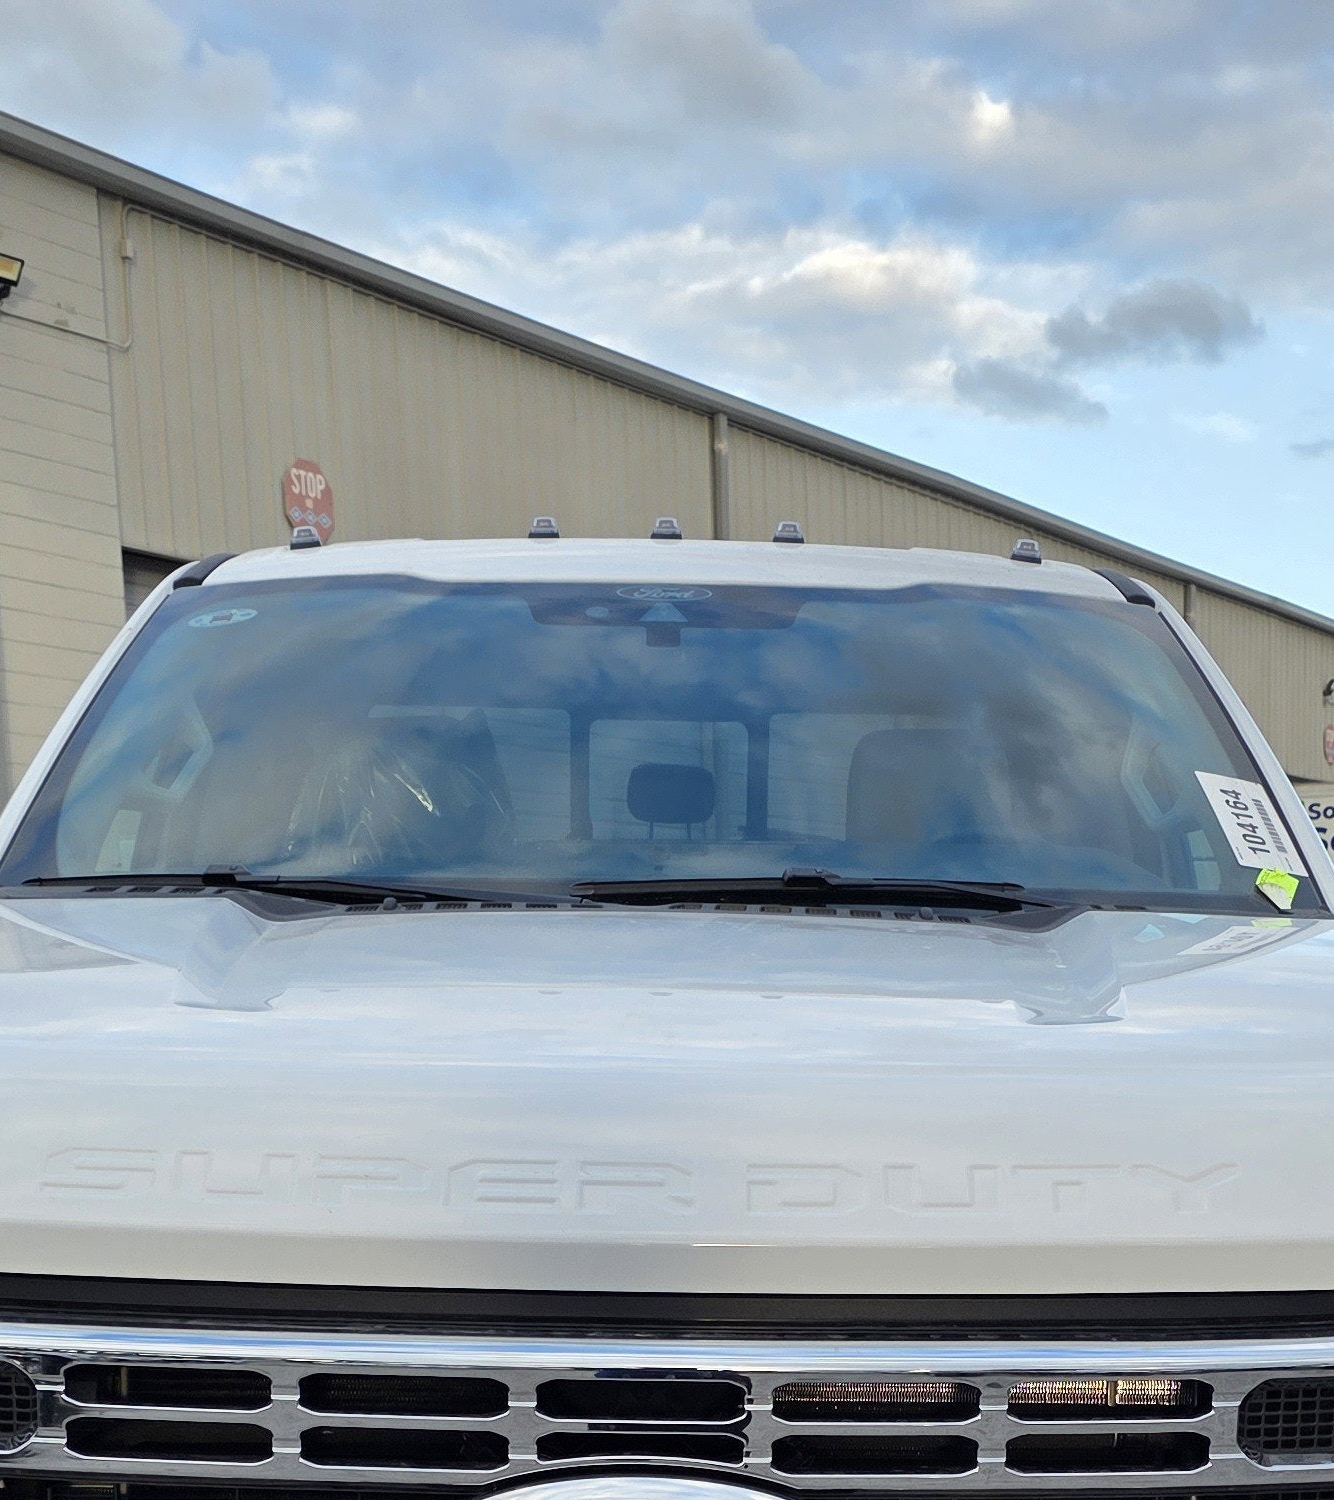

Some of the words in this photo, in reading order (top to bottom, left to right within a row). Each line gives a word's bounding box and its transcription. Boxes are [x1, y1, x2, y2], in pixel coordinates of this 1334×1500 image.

[291, 468, 326, 499] STOP
[633, 586, 696, 598] Ford
[1219, 788, 1271, 855] 104164
[38, 1147, 694, 1216] SUPER
[745, 1162, 1240, 1216] DUTY
